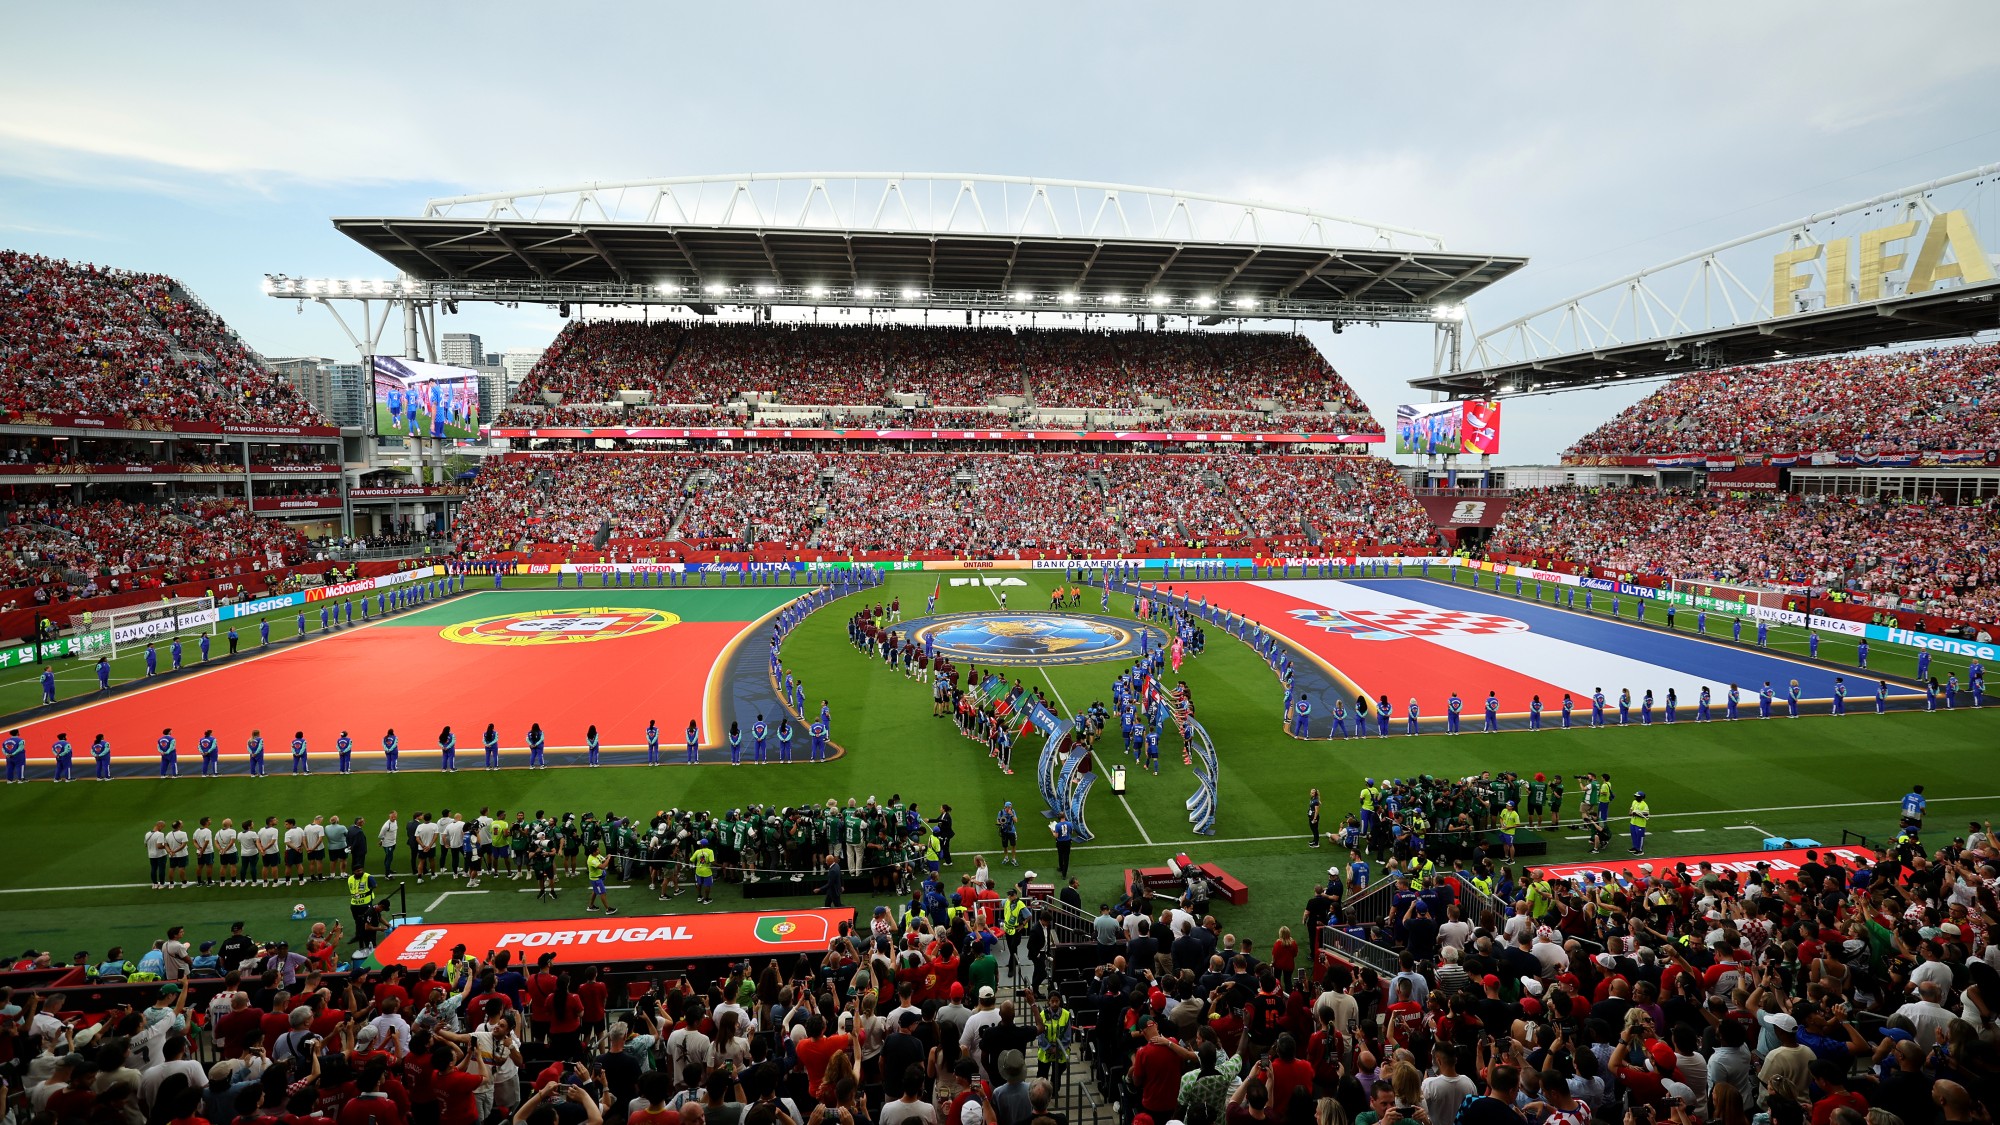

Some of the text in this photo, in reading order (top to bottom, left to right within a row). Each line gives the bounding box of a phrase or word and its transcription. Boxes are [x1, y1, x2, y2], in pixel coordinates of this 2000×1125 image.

[1774, 209, 1998, 317] FIFA
[698, 562, 790, 573] Michelob ULTRA
[1174, 559, 1225, 568] Hisense
[1286, 557, 1347, 567] McDonald's
[530, 564, 549, 574] Lay's
[575, 563, 615, 573] verizon
[632, 563, 671, 573] verizon
[390, 574, 407, 585] Dove
[1532, 571, 1561, 583] verizon
[1603, 570, 1617, 578] FIFA
[218, 582, 234, 592] FIFA
[950, 577, 1028, 586] FIFA
[325, 578, 374, 598] McDonald's
[1580, 577, 1654, 598] Michelob ULTRA
[234, 596, 293, 617] Hisense
[1750, 607, 1846, 632] BANK OF AMERICA
[114, 614, 206, 640] BANK OF AMERICA
[1888, 627, 1994, 659] Hisense
[973, 656, 1038, 664] WORLD
[1041, 656, 1076, 664] CUP
[1133, 672, 1140, 680] 22
[1036, 710, 1056, 731] FIFA
[1134, 728, 1142, 736] 24
[1151, 737, 1155, 746] 9
[495, 925, 693, 948] PORTUGAL
[134, 1045, 150, 1063] 7
[327, 1104, 339, 1121] 7
